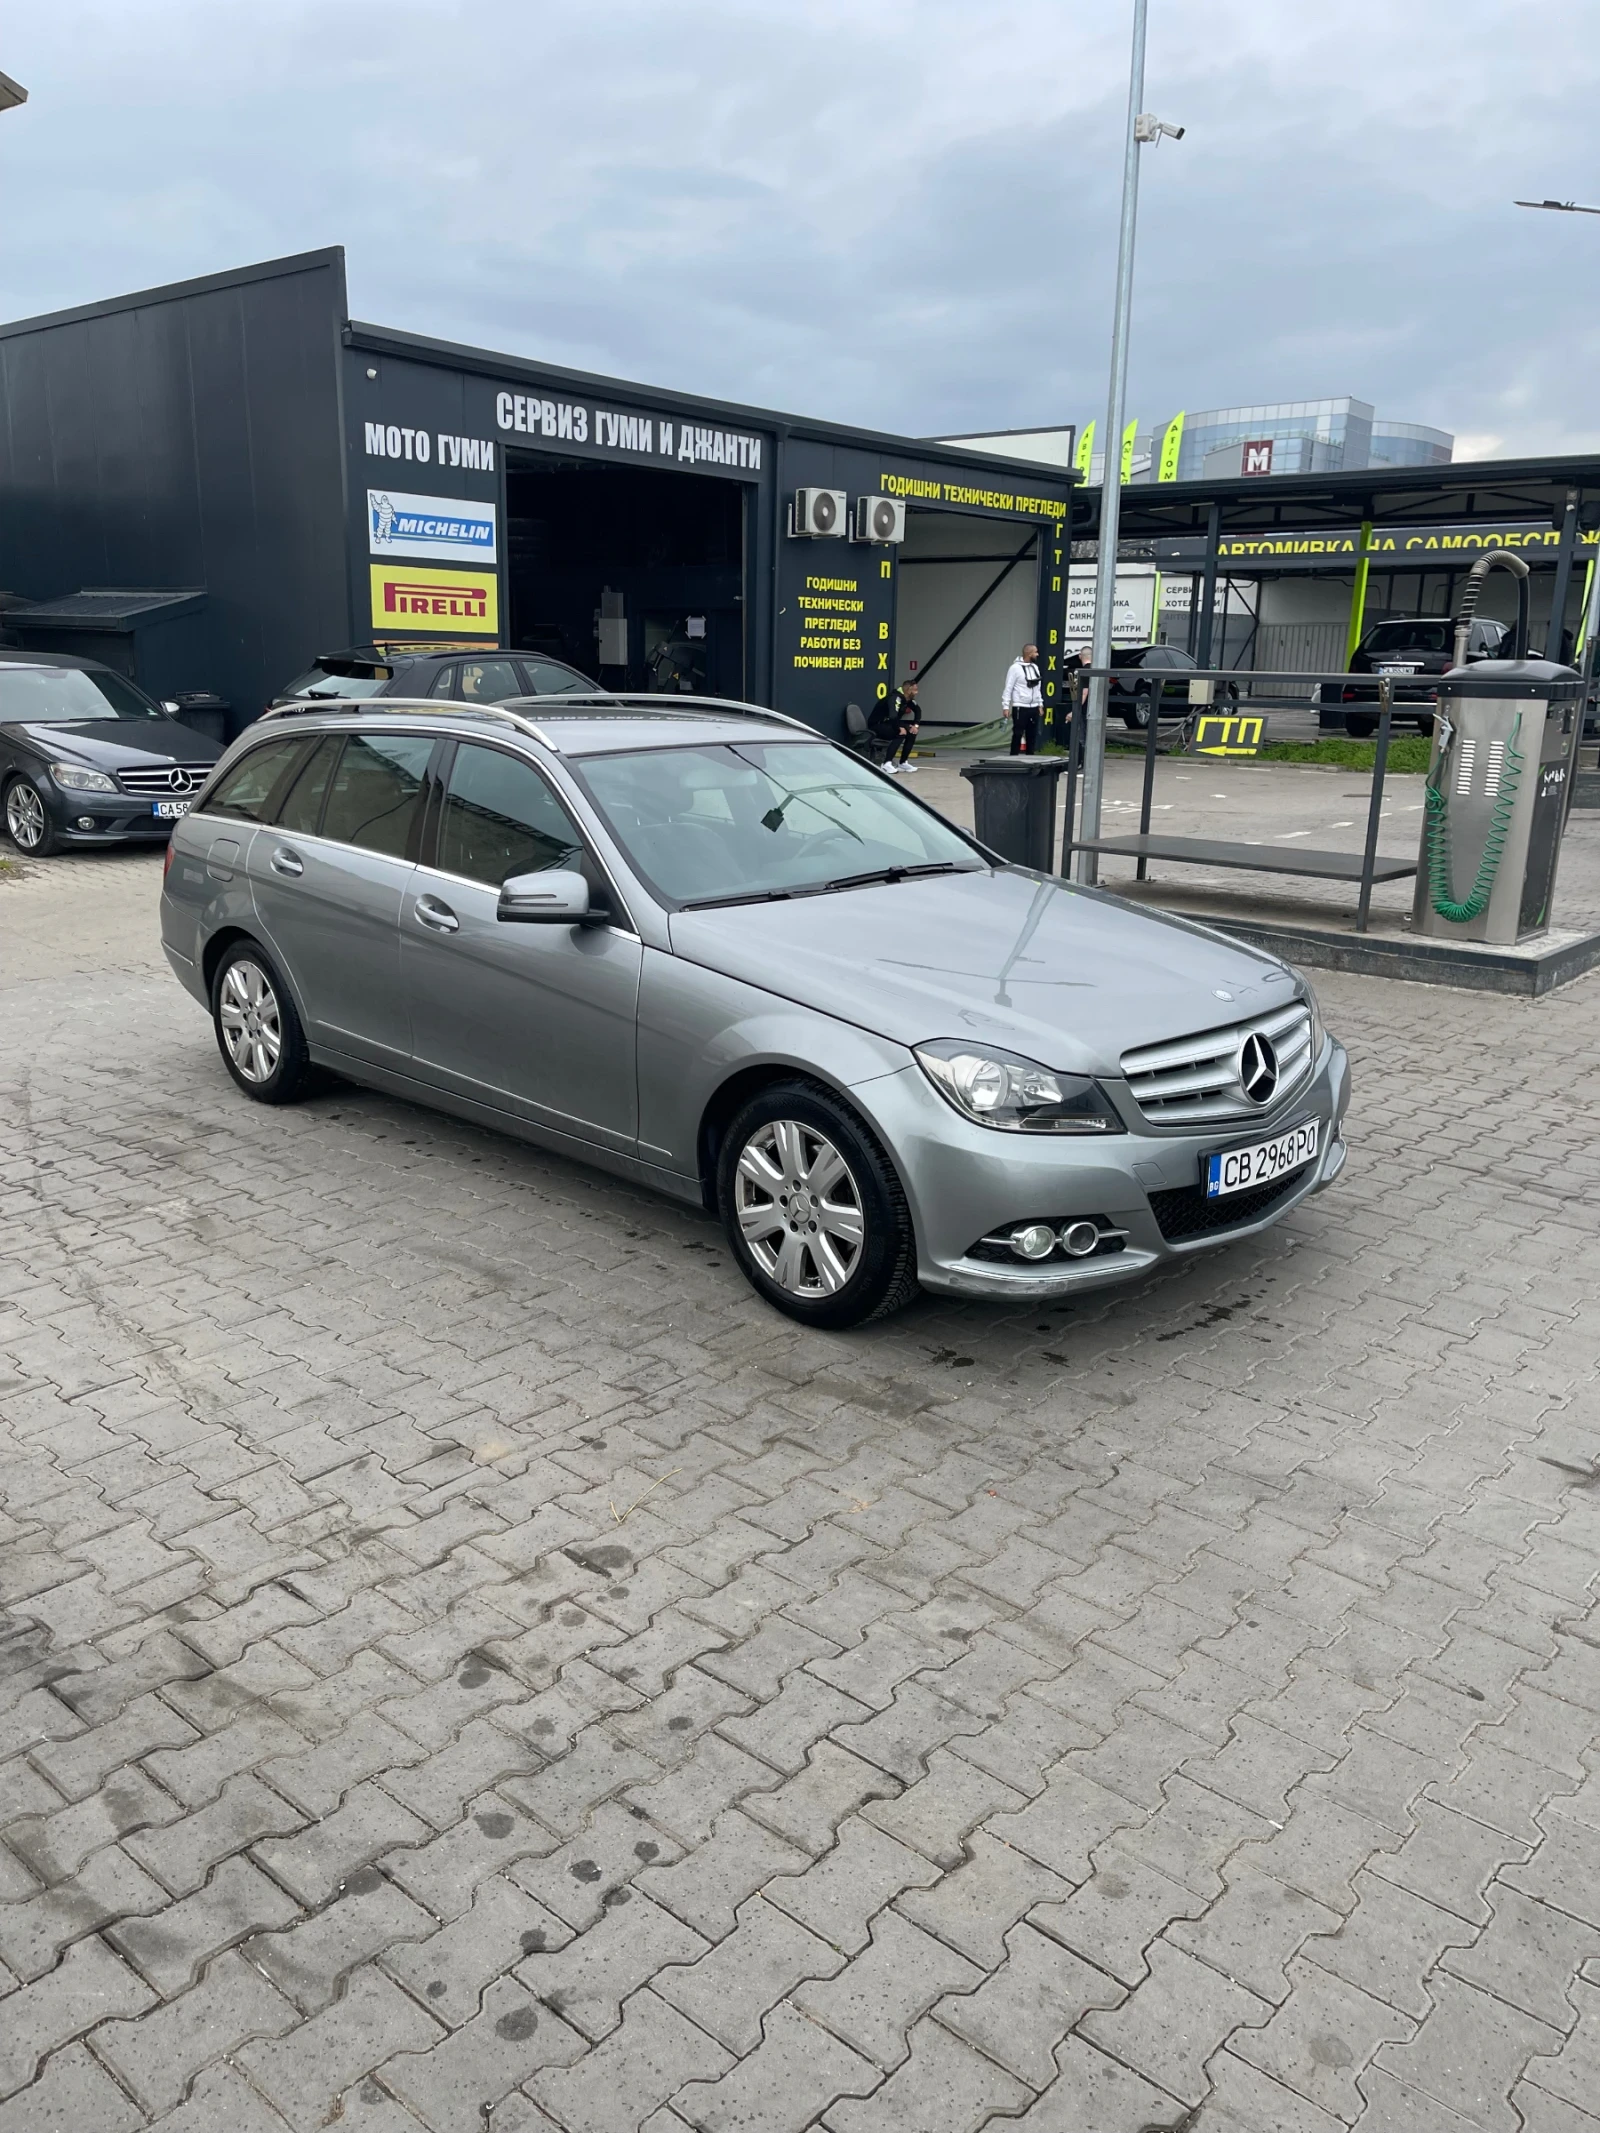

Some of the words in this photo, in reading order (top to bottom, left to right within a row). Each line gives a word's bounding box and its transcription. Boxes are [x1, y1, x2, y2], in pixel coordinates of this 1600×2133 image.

[496, 391, 588, 442] СЕРВИЗ
[595, 410, 652, 453] ГУМИ
[659, 421, 673, 455] И
[678, 424, 761, 470] ДЖАНТИ
[365, 422, 430, 463] МОТО
[438, 434, 494, 471] ГУМИ
[1247, 447, 1269, 472] M
[880, 474, 941, 499] ГОДИШНИ
[943, 484, 1014, 511] ТЕХНИЧЕСКИ
[1015, 496, 1067, 519] ПРЕГЛЕДИ
[398, 518, 490, 540] MICHELIN
[1218, 539, 1354, 555] АВТОМИВКА
[1052, 523, 1063, 592] ГТП
[806, 577, 857, 592] ГОДИШНИ
[1071, 587, 1081, 595] 3D
[1166, 586, 1193, 594] СЕРВИ
[384, 582, 487, 617] PIRELLI
[798, 596, 864, 612] ТЕХНИЧЕСКИ
[1069, 600, 1130, 608] ДИАГНИКА
[804, 617, 857, 633] ПРЕГЛЕДИ
[1112, 625, 1141, 633] ИЛТРИ
[800, 636, 841, 650] РАБОТИ
[842, 638, 861, 650] БЕЗ
[794, 655, 842, 668] ПОЧИВЕН
[843, 657, 864, 670] ДЕН
[877, 622, 889, 699] ВХО
[1044, 630, 1057, 725] ВХОД
[1196, 716, 1264, 744] ГТП
[160, 804, 174, 815] CA
[176, 803, 188, 814] 58
[1225, 1153, 1251, 1187] CB
[1256, 1136, 1294, 1179] 2968
[1209, 1181, 1219, 1192] BG
